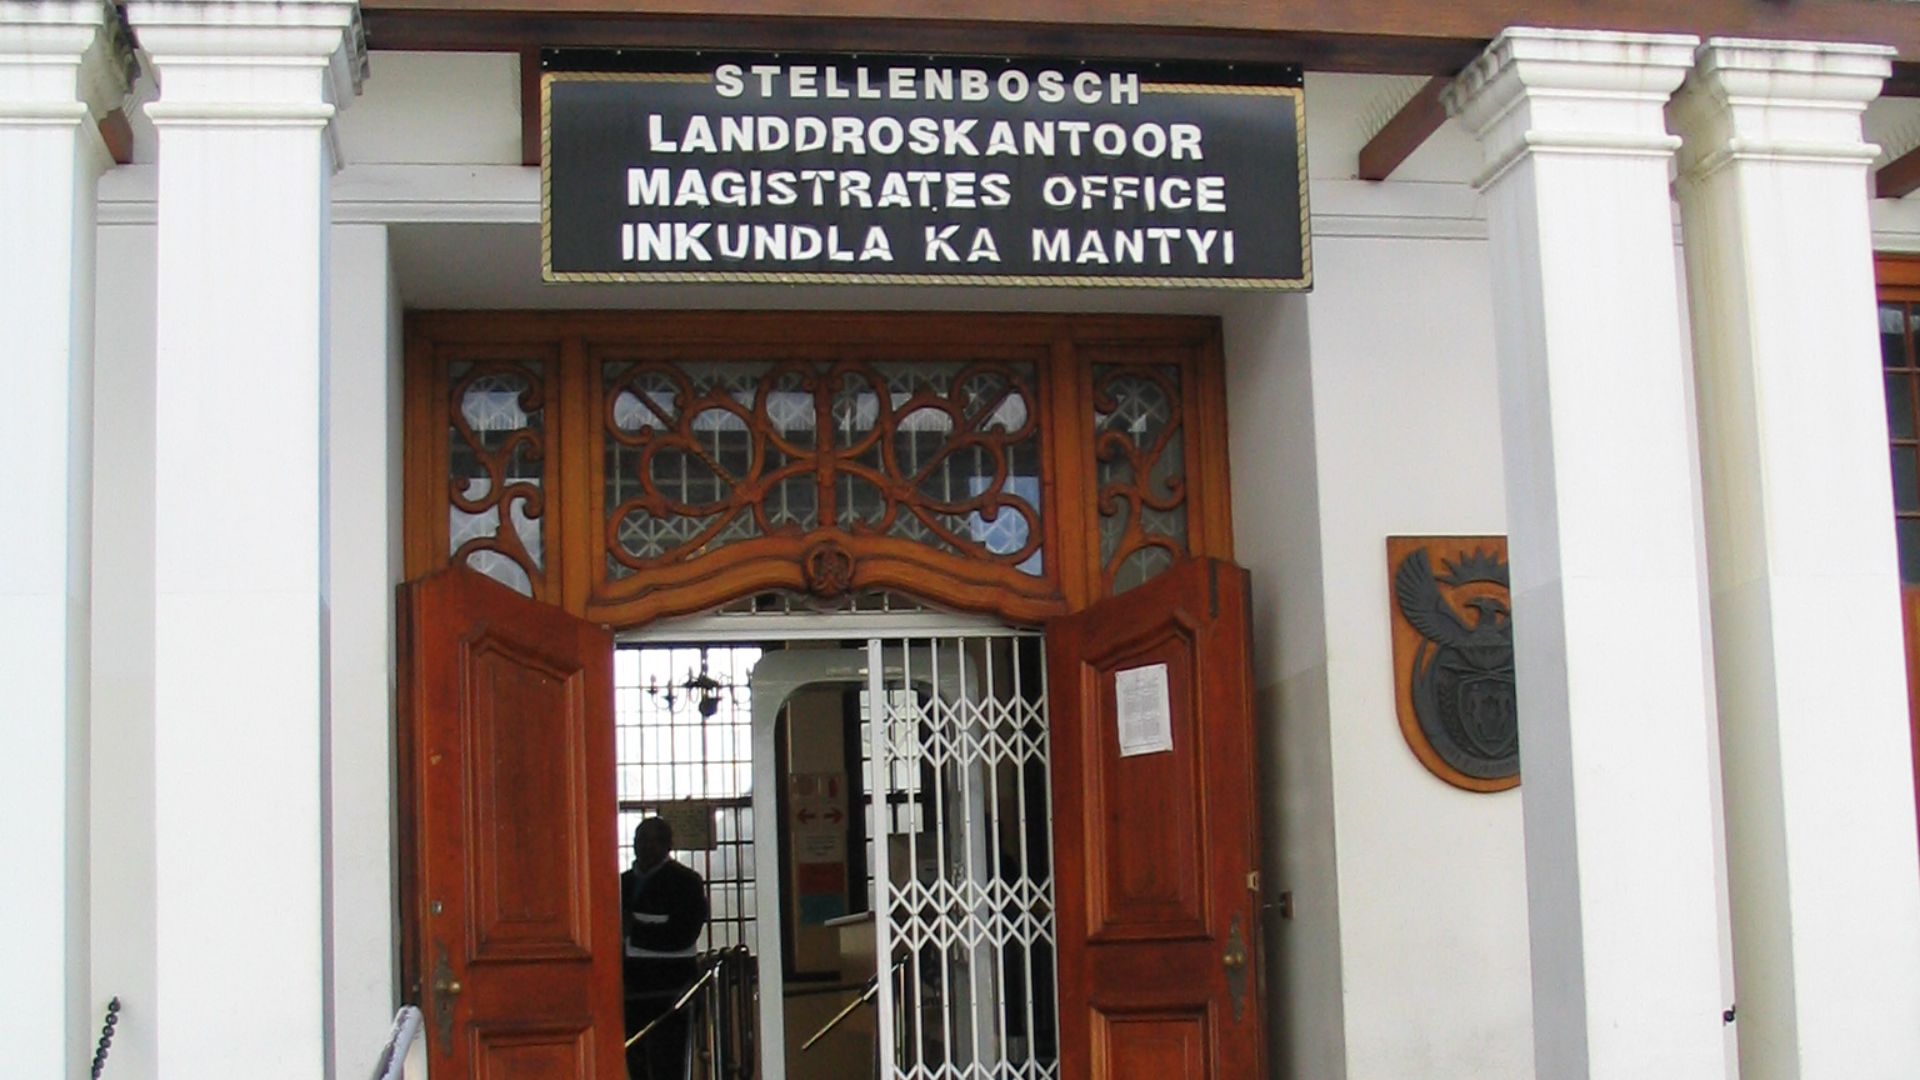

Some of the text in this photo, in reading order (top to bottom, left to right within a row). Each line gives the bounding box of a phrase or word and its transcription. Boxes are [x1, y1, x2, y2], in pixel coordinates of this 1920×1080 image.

[715, 64, 1140, 105] STELLENBOSCH
[648, 114, 1204, 160] LANDDROSKANTOOR
[627, 168, 1227, 213] MAGISTRATES OFFICE
[621, 222, 1235, 265] INKUNDLA KA MANTYI
